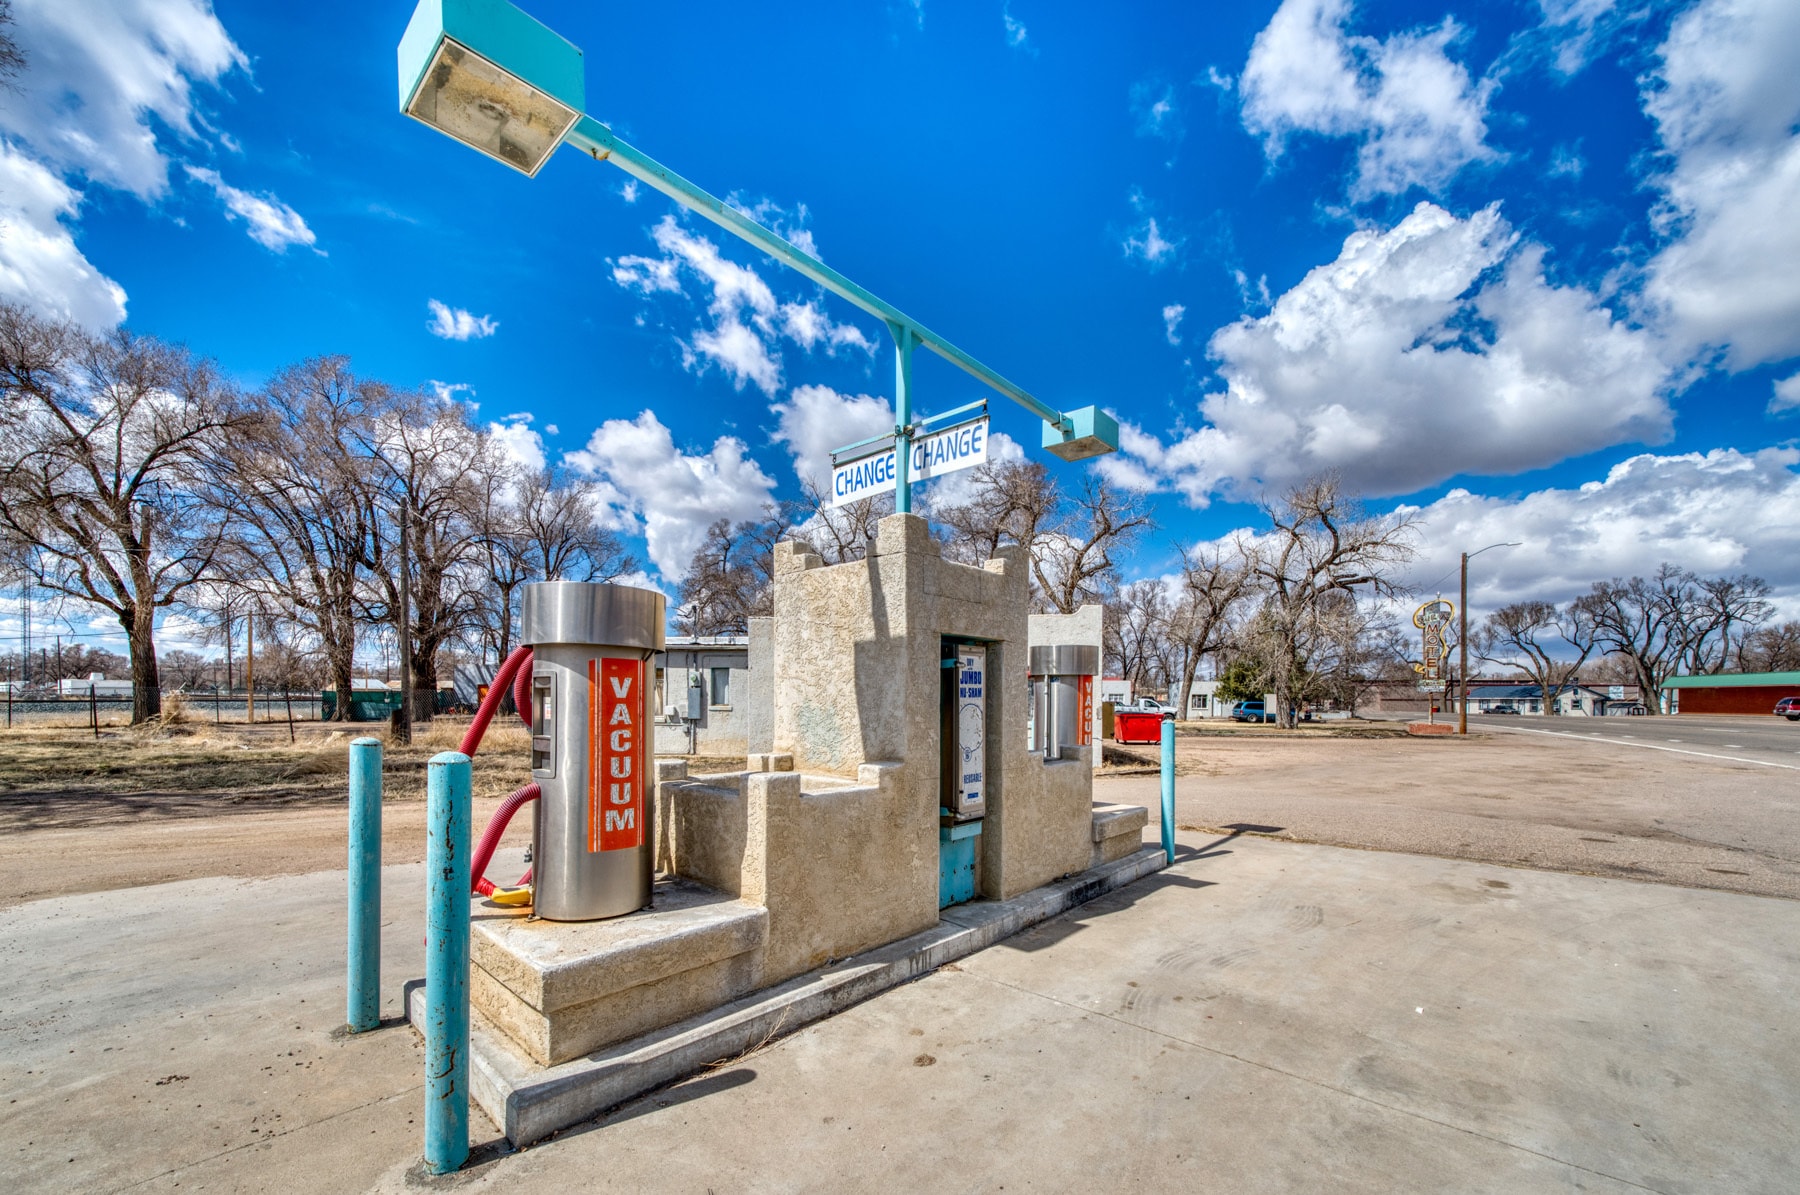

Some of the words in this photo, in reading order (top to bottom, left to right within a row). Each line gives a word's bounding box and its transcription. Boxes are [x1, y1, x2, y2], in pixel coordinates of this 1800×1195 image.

[913, 425, 982, 470] CHANGE
[836, 453, 895, 497] CHANGE
[1426, 624, 1438, 679] MOTEL
[960, 671, 982, 685] JUMBO
[1084, 682, 1092, 746] VACUU
[605, 676, 635, 832] VACUUM
[964, 772, 982, 784] REUSABLE
